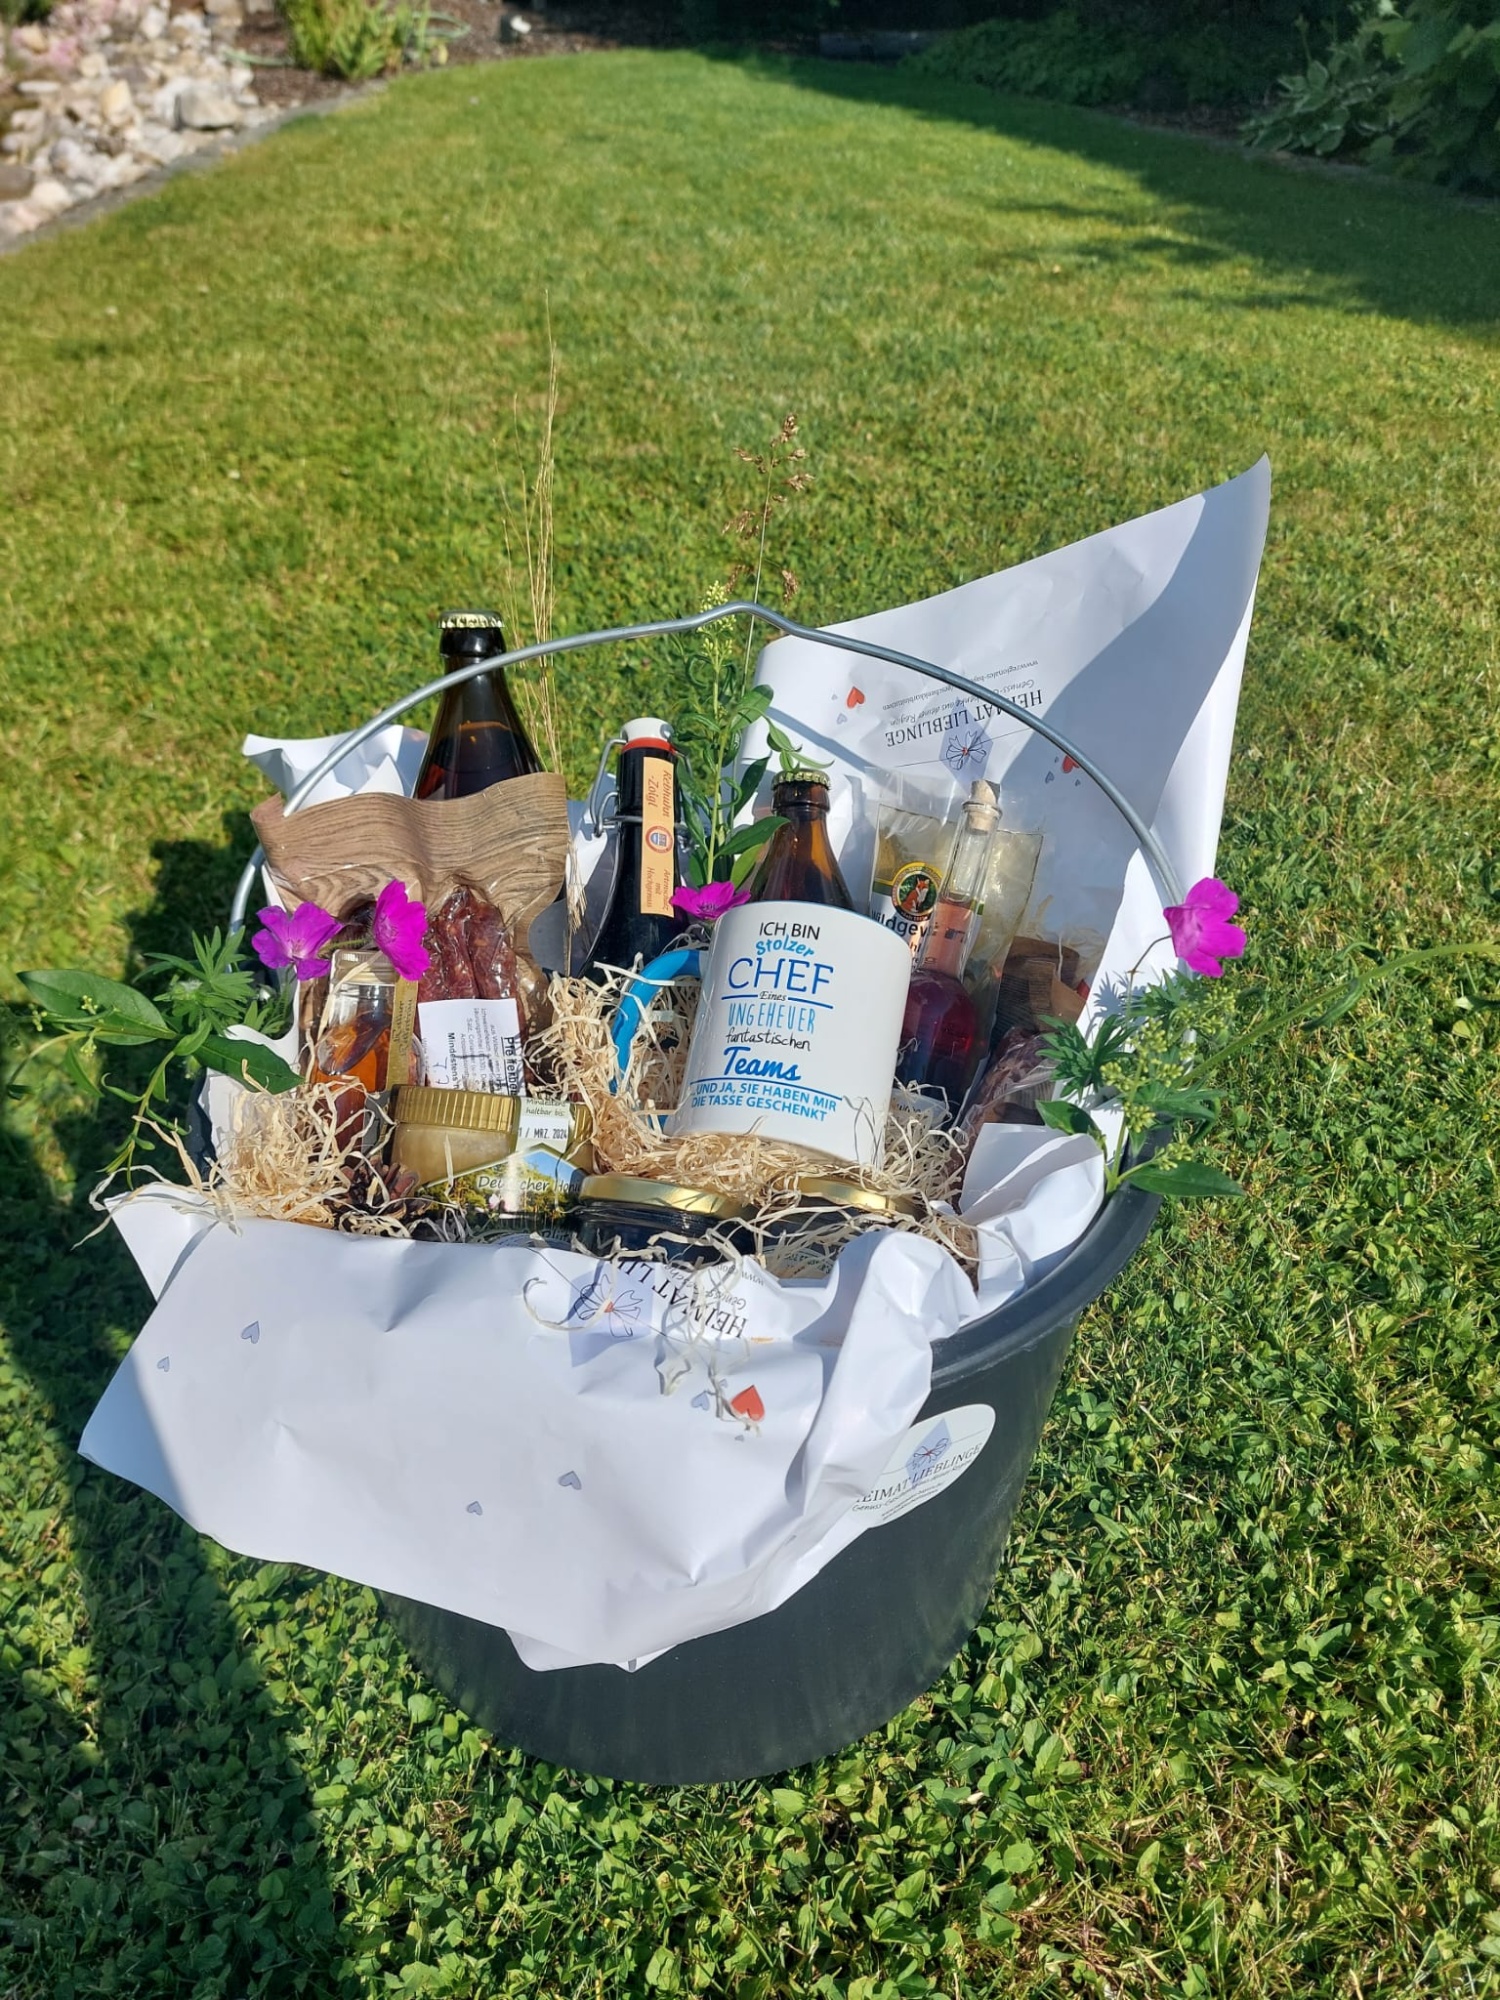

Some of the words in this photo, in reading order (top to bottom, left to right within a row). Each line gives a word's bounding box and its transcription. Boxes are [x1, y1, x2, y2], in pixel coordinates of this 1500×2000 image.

[885, 709, 969, 748] LIEBLINGE
[890, 713, 916, 727] Region
[759, 922, 787, 938] ICH
[792, 923, 820, 941] BIN
[728, 957, 834, 995] CHEF
[759, 990, 787, 1002] Eines
[728, 1002, 816, 1034] UNGEHEUER
[725, 1026, 811, 1051] fantastischen
[723, 1046, 801, 1081] Teams
[525, 1107, 551, 1115] haltbar
[691, 1096, 706, 1108] DIE
[709, 1095, 743, 1106] TASSE
[746, 1096, 828, 1121] GESCHENKT
[719, 1082, 736, 1095] JA,
[740, 1083, 759, 1095] SIE
[762, 1085, 809, 1104] HABEN
[812, 1095, 837, 1112] MIR
[911, 1443, 983, 1483] LIEBLINGE
